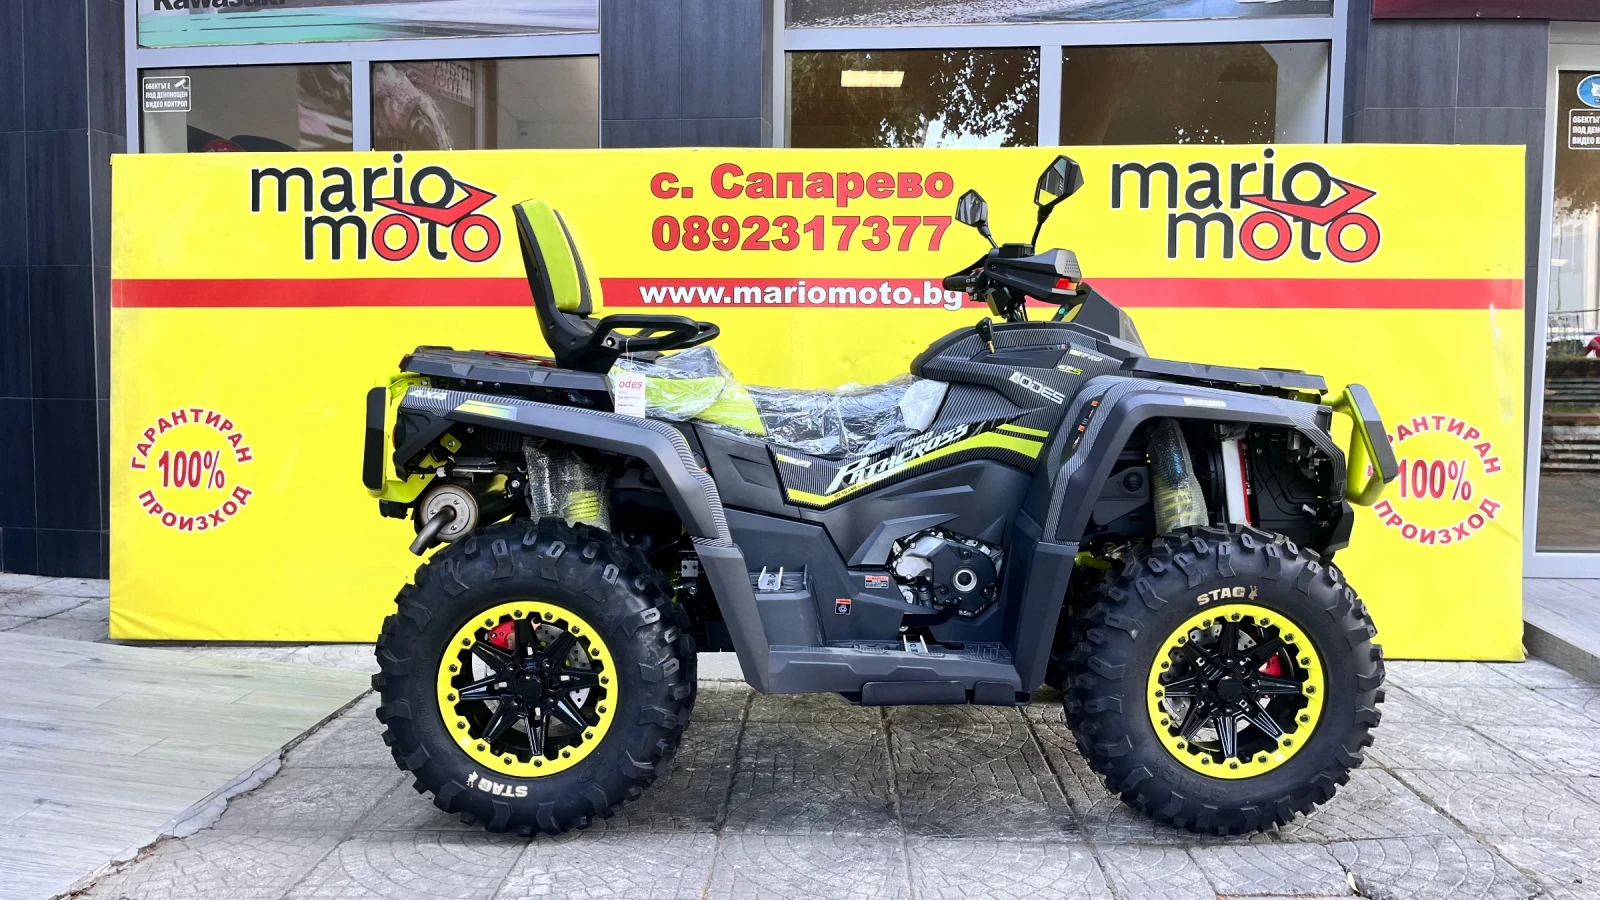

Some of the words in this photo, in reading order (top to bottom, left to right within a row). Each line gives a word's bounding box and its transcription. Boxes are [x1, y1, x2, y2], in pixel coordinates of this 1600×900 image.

[153, 0, 286, 11] Kawasa
[145, 91, 157, 99] ПОД
[157, 91, 188, 99] ДЕНОНОЩЕН
[145, 101, 164, 109] ВИДЕО
[164, 100, 188, 108] КОНТРОЛ
[1572, 127, 1586, 135] ПОД
[1572, 137, 1595, 145] ВИДЕО
[251, 153, 455, 213] mario
[650, 171, 694, 199] с.
[710, 162, 955, 208] Сапарево
[1110, 148, 1332, 209] mario
[304, 211, 502, 263] moto
[651, 214, 953, 251] 0892317377
[1166, 209, 1381, 263] moto
[638, 280, 963, 311] www.mariomoto.bg
[618, 379, 643, 389] odes
[1008, 371, 1066, 405] AODES
[131, 408, 253, 469] ГАРАНТИРАН
[901, 431, 932, 448] 1000
[1367, 415, 1502, 477] ГАНТИРАН
[158, 450, 226, 490] 100%
[1397, 459, 1472, 502] 100%
[138, 485, 253, 532] ПРОИЗХОД
[1373, 497, 1501, 545] ПРОИЗХОД
[1196, 586, 1247, 606] STAG
[477, 776, 529, 798] STAG
